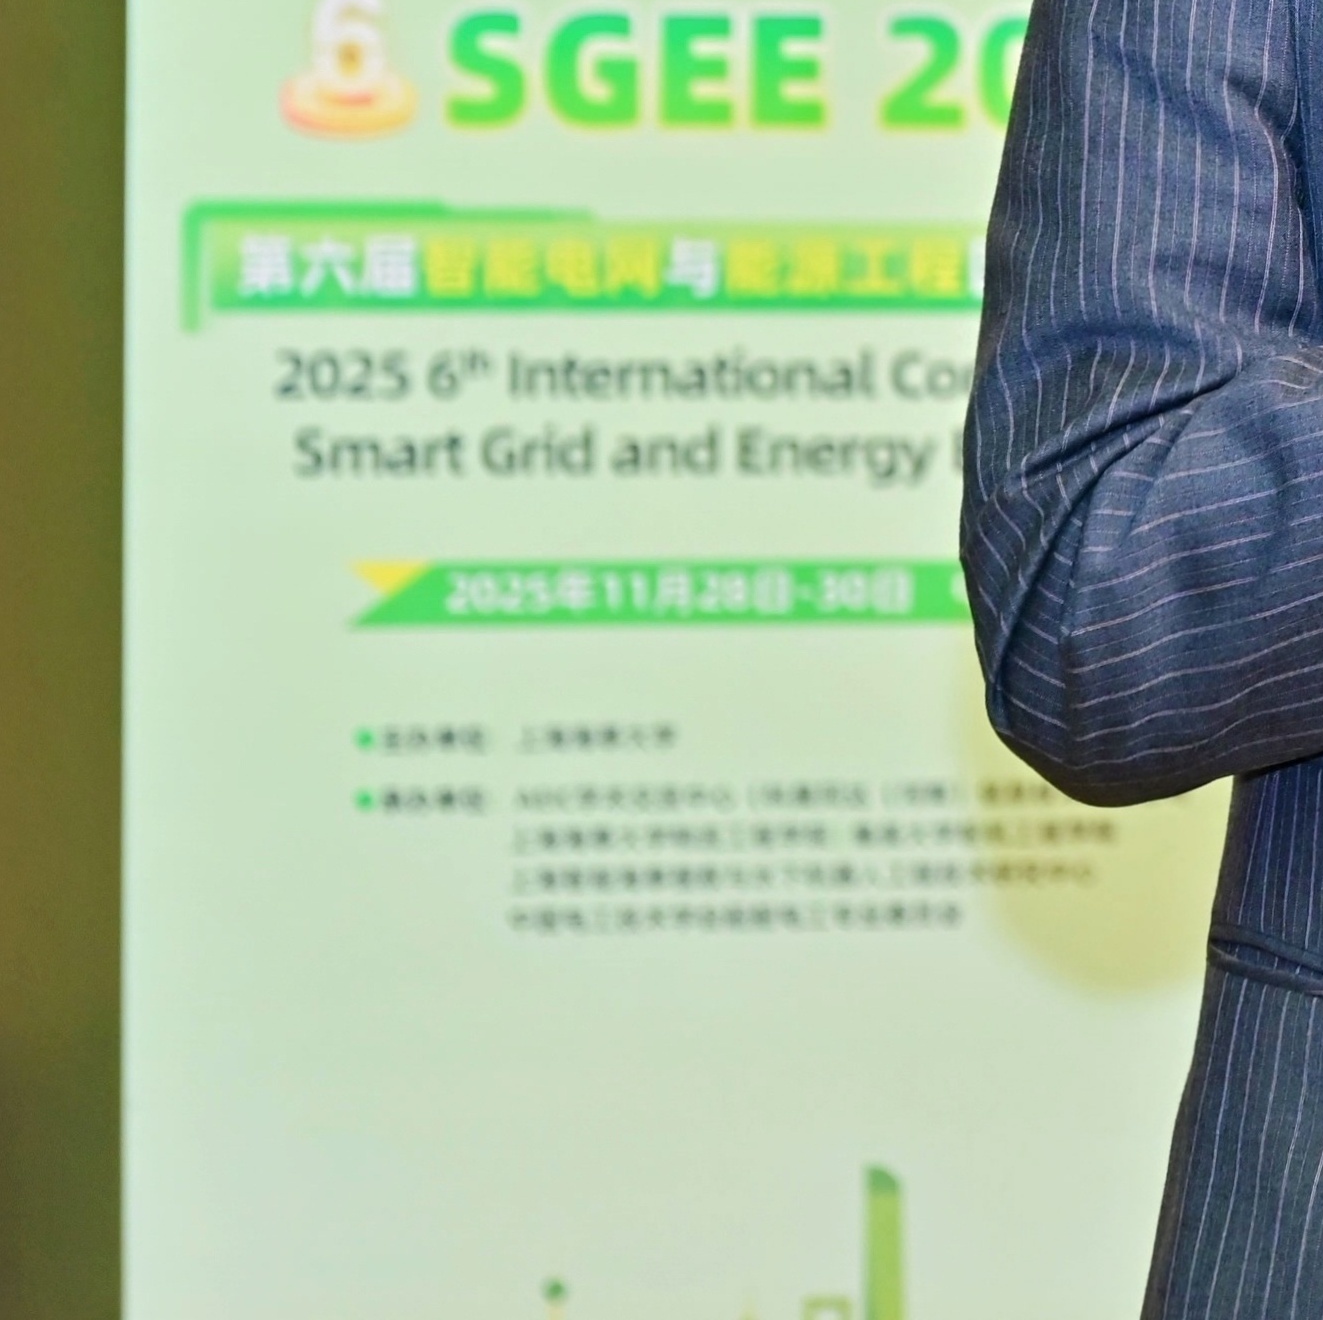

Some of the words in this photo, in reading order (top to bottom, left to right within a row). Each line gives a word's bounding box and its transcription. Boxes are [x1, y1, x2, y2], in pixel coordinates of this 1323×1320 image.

[444, 8, 828, 129] SGEE
[275, 349, 412, 402] 2025
[425, 347, 490, 401] 6th
[507, 347, 876, 401] International
[294, 426, 464, 478] Smart
[480, 425, 596, 478] Grid
[612, 427, 720, 477] and
[737, 426, 936, 488] Energy
